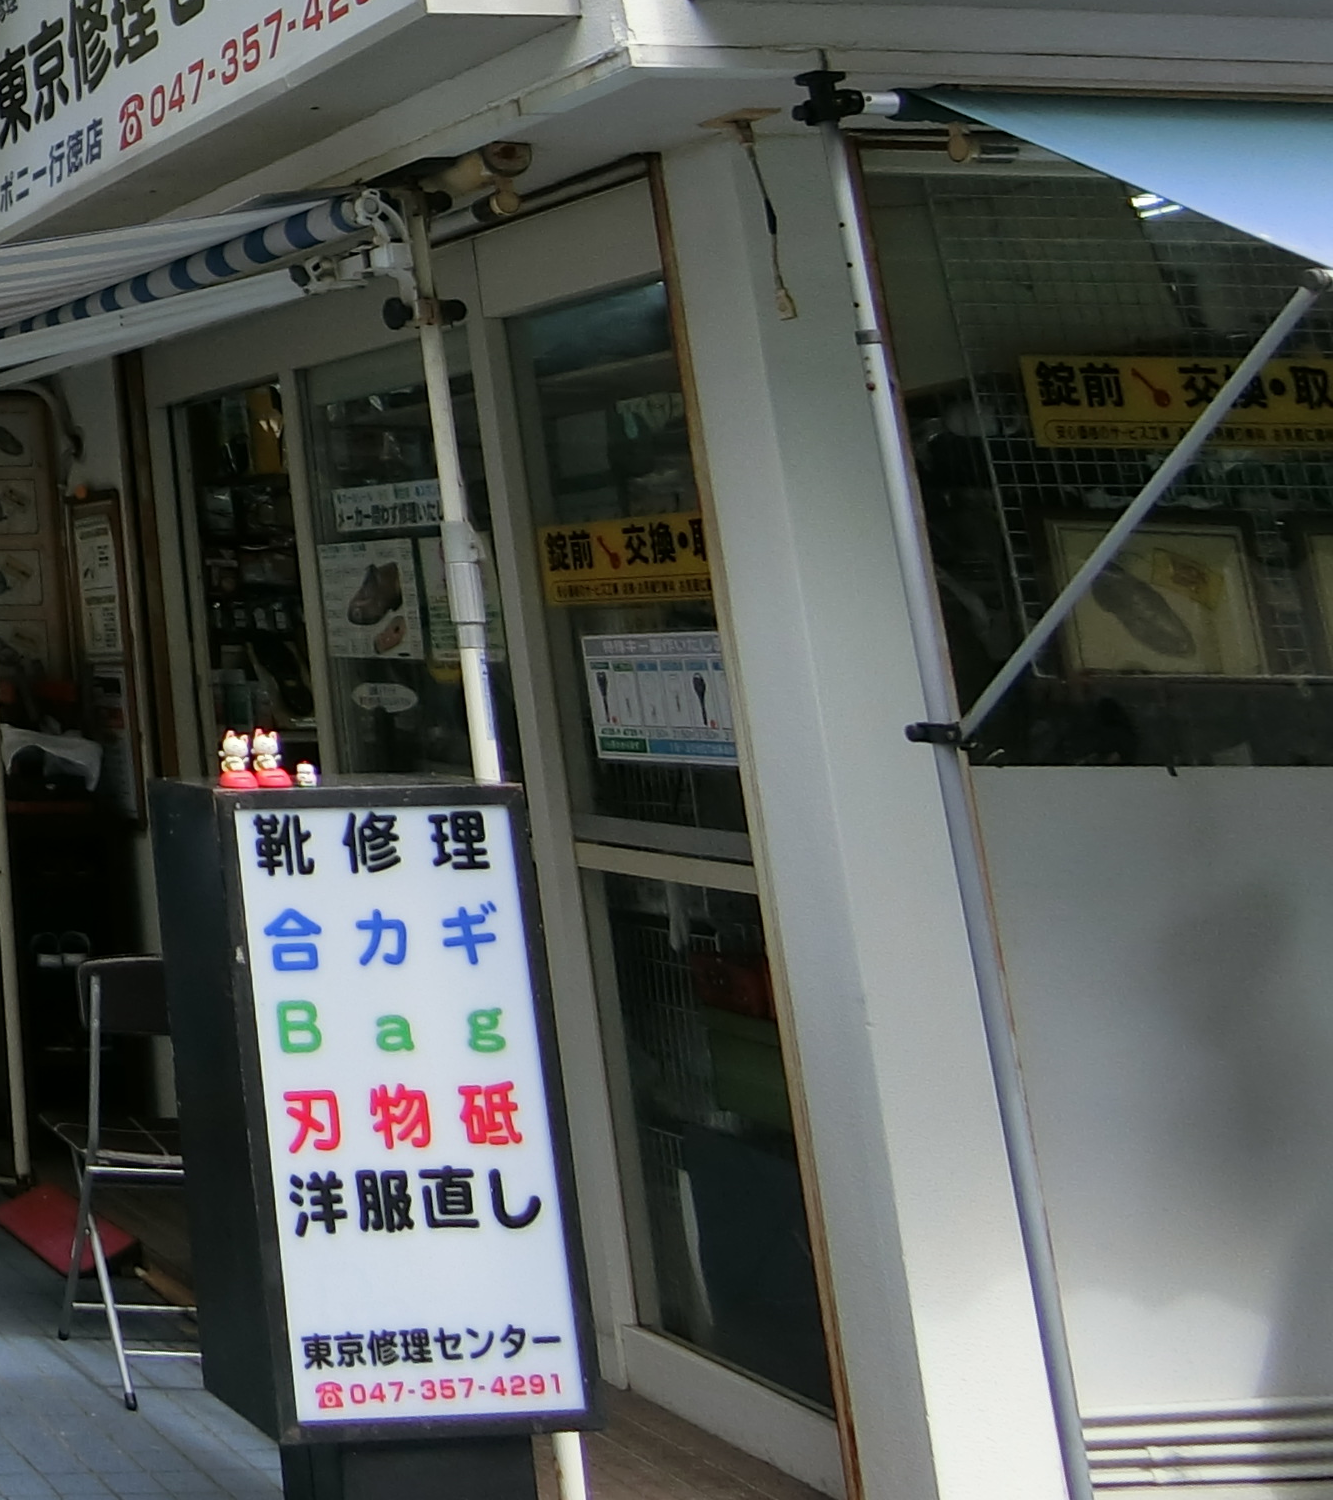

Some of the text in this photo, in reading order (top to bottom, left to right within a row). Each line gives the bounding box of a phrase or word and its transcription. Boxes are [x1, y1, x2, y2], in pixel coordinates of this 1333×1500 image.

[1035, 361, 1125, 409] 錠前
[546, 529, 594, 572] 錠前
[253, 810, 492, 876] 靴修理
[263, 905, 498, 972] 合カギ
[276, 999, 508, 1054] Bag
[283, 1082, 523, 1153] 刃物砥
[289, 1165, 541, 1237] 洋服直し
[301, 1323, 564, 1369] 東京修理センター
[349, 1373, 564, 1407] 047-357-4291
